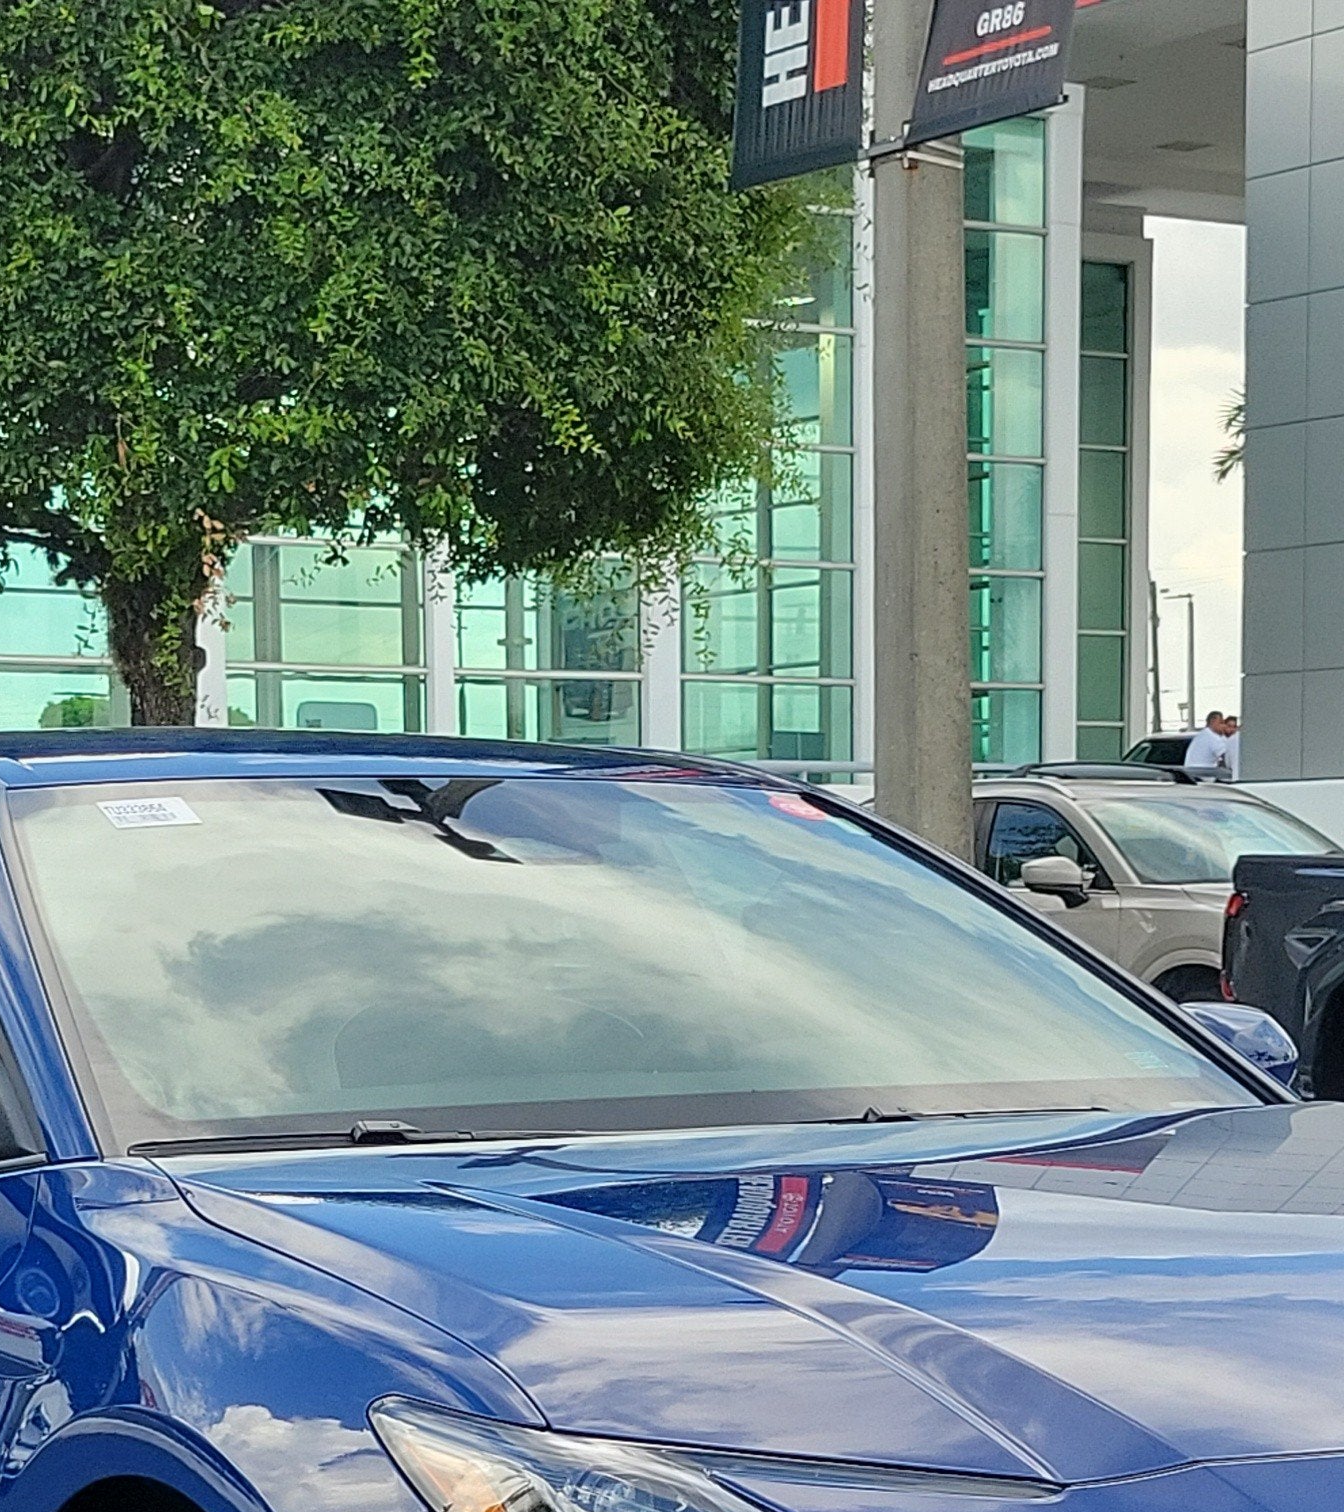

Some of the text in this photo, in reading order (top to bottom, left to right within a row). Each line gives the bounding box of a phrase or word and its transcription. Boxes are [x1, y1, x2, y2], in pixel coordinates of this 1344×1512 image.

[976, 1, 1026, 37] GR86
[762, 0, 809, 108] HE
[928, 42, 1060, 93] HEADQUARTERTOYOTA.COM
